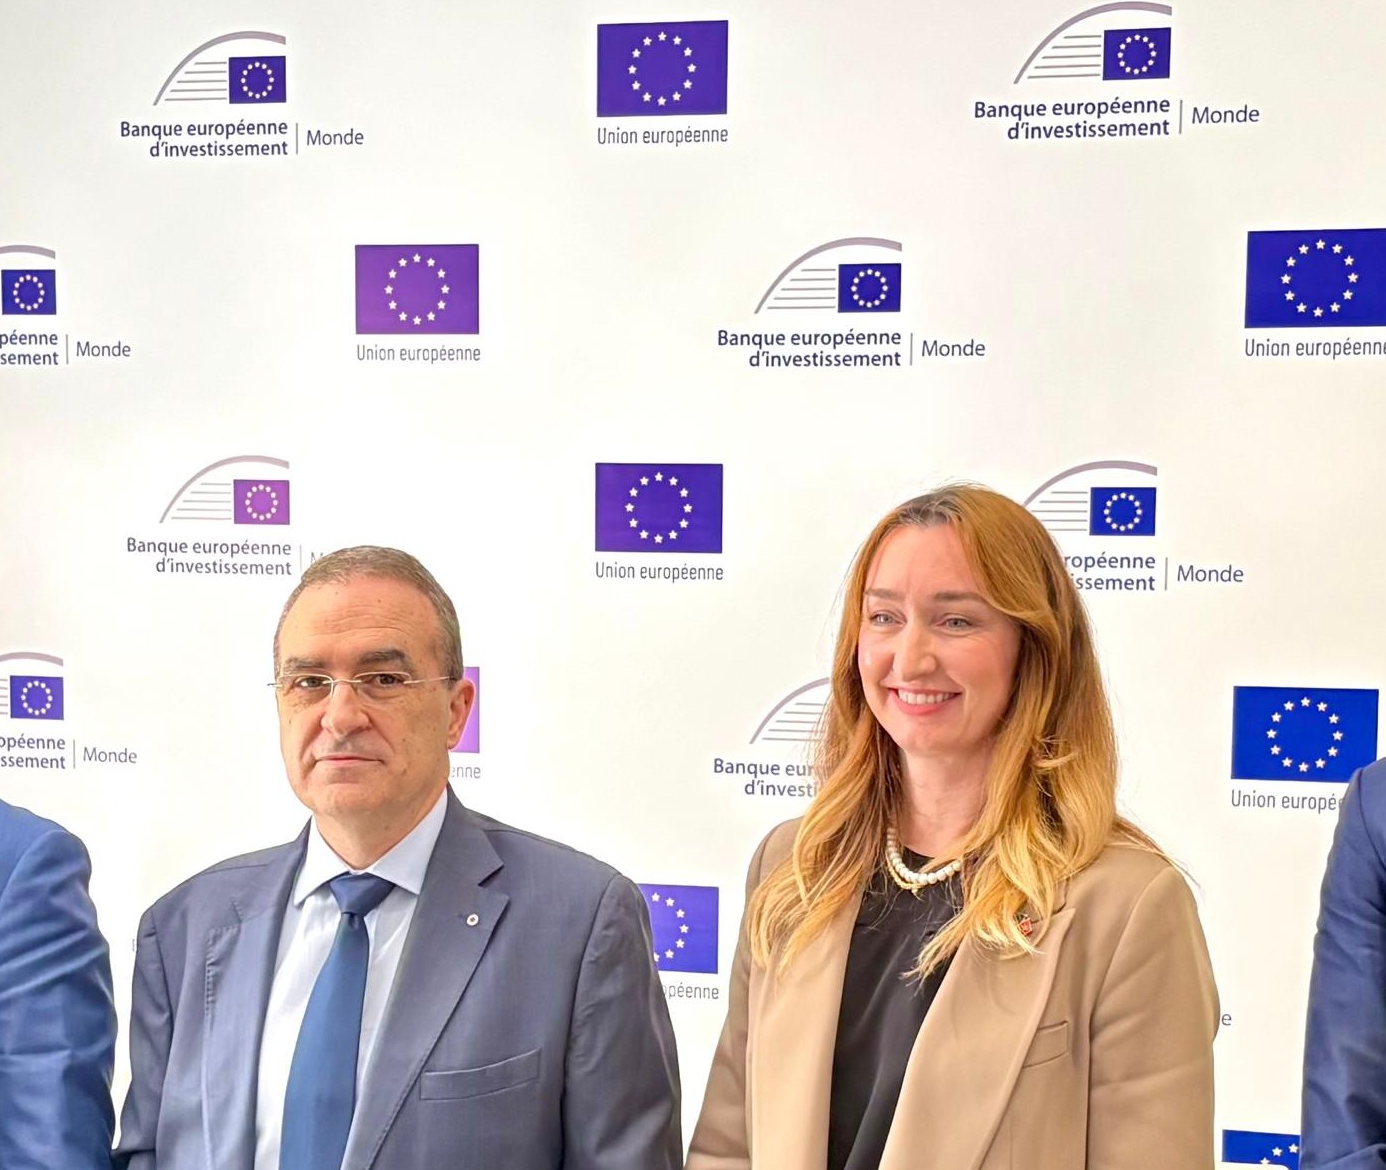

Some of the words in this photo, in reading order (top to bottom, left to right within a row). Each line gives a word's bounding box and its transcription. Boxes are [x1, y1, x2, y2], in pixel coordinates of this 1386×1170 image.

[974, 101, 1047, 122] Banque
[1051, 97, 1171, 120] européenne
[1191, 104, 1260, 125] Monde
[120, 121, 183, 141] Banque
[186, 118, 289, 140] européenne
[306, 127, 365, 146] Monde
[597, 126, 637, 145] Union
[642, 125, 729, 147] européenne
[1007, 120, 1170, 140] d'investissement
[149, 140, 288, 158] d'investissement
[76, 340, 132, 358] Monde
[717, 329, 786, 352] Banque
[790, 327, 902, 350] européenne
[921, 338, 986, 357] Monde
[1244, 337, 1290, 357] Union
[356, 344, 396, 362] Union
[399, 343, 481, 365] européenne
[748, 350, 902, 368] d'investissement
[126, 536, 189, 556] Banque
[192, 539, 292, 558] européenne
[155, 558, 292, 576] d'investissement
[595, 561, 636, 579] Union
[639, 561, 724, 583] européenne
[1064, 551, 1156, 572] ropéenne
[1177, 563, 1245, 583] Monde
[82, 746, 138, 764] Monde
[713, 757, 781, 779] Banque
[1231, 788, 1276, 809] Union
[1281, 792, 1337, 815] europé
